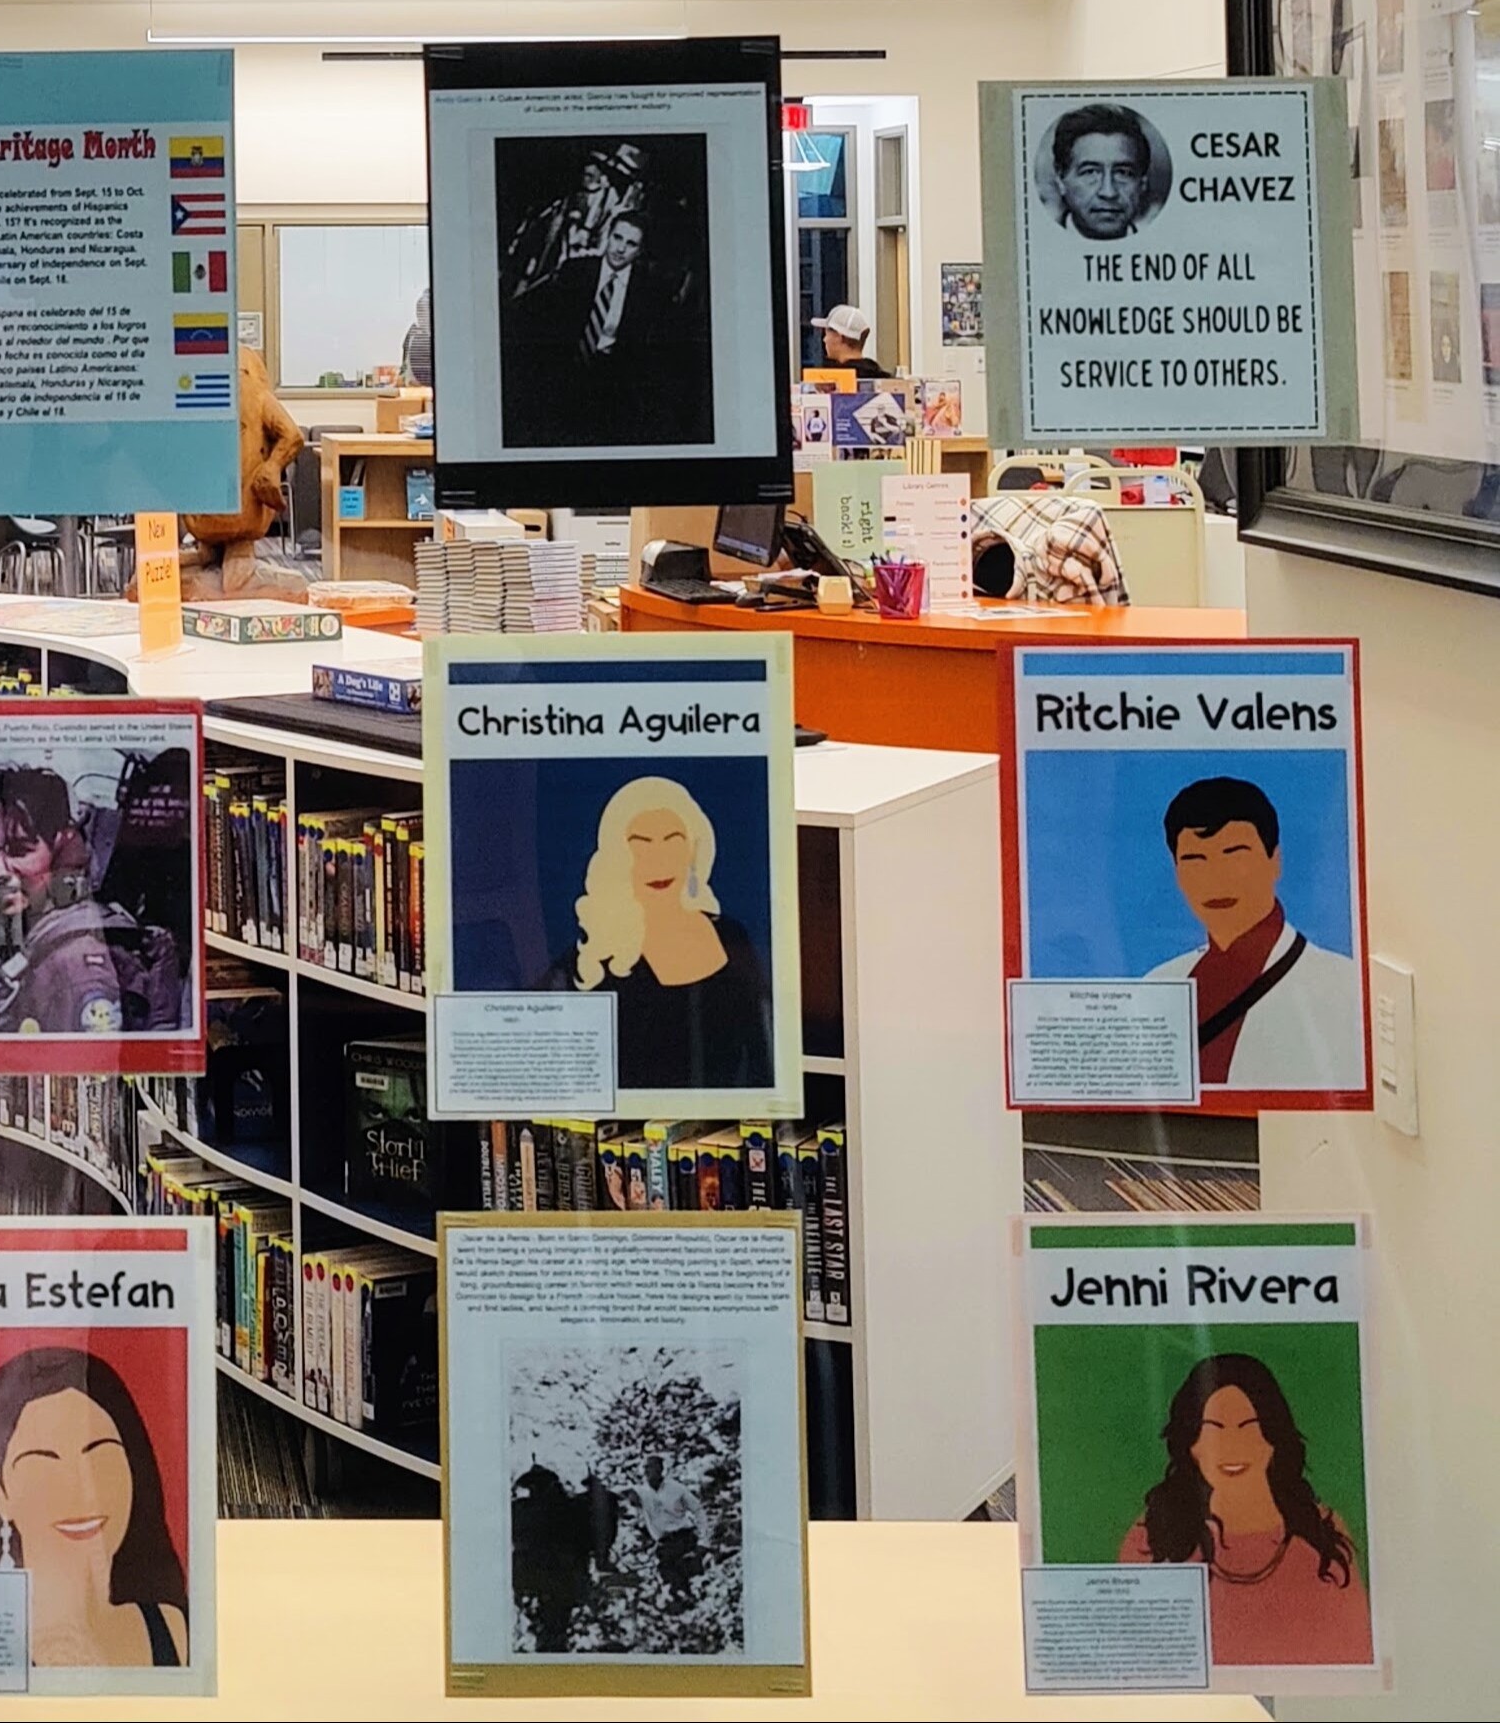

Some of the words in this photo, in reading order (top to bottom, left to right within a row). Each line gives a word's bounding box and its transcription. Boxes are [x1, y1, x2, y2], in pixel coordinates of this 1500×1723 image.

[83, 128, 157, 160] Month
[1191, 132, 1280, 158] CESAR
[1179, 176, 1295, 203] CHAVEZ
[1083, 254, 1123, 282] THE
[1131, 253, 1176, 281] END
[1183, 253, 1209, 280] OF
[1217, 253, 1255, 281] ALL
[1040, 306, 1175, 335] KNOWLEDGE
[1183, 305, 1270, 334] SHOULD
[1277, 305, 1303, 333] BE
[1060, 359, 1153, 388] SERVICE
[1160, 359, 1187, 387] TO
[1194, 358, 1286, 387] OTHERS.
[148, 519, 166, 541] New
[859, 500, 874, 545] right
[337, 673, 346, 687] A
[346, 674, 369, 691] Dog's
[370, 677, 384, 693] Life
[458, 704, 604, 736] Christina
[619, 703, 760, 742] Aguilera
[1036, 691, 1180, 732] Ritchie
[1197, 692, 1337, 731] Valens
[825, 1176, 837, 1194] THE
[823, 1198, 844, 1237] LAST
[805, 1216, 822, 1276] INFINITE
[823, 1240, 845, 1280] STAR
[26, 1270, 174, 1309] Estefan
[1050, 1267, 1168, 1307] Jenni
[1187, 1265, 1339, 1306] Rivera
